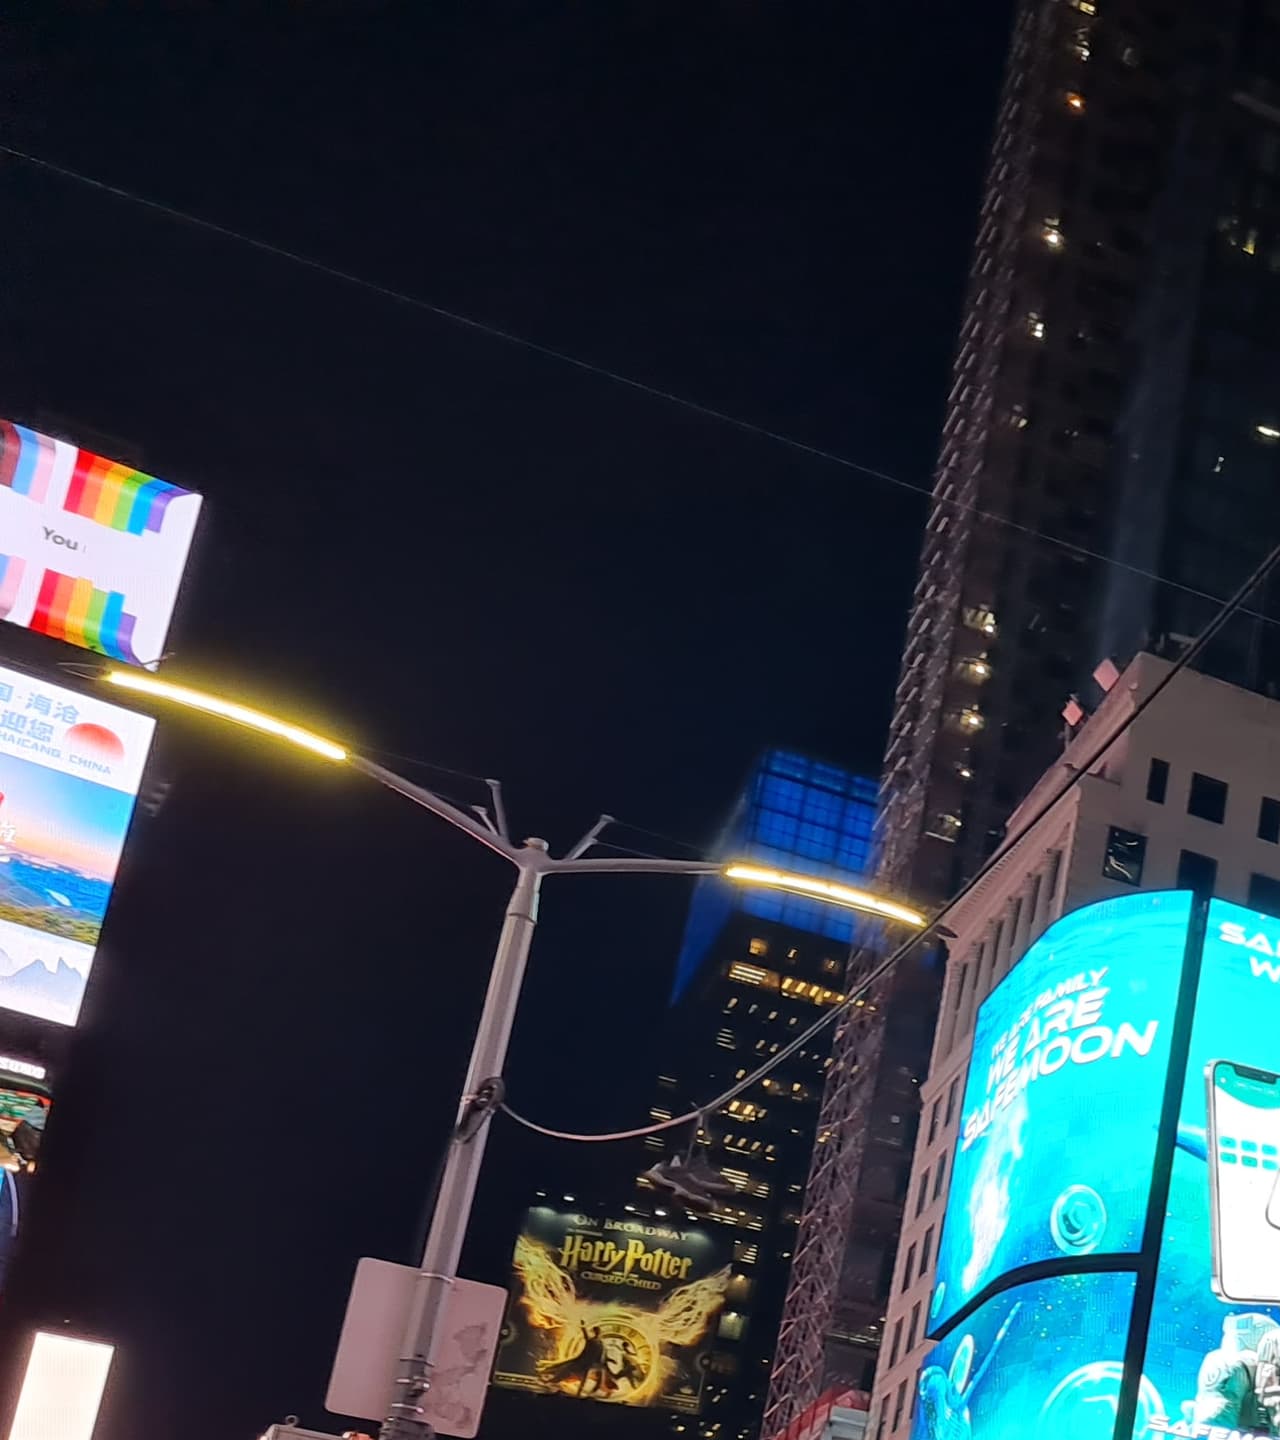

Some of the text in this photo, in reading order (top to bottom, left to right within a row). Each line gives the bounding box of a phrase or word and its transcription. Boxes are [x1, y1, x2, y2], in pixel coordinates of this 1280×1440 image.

[42, 525, 79, 550] You
[68, 754, 112, 776] CHINA
[1021, 986, 1111, 1059] ARE
[961, 1019, 1160, 1153] SAFEMOON
[573, 1214, 690, 1242] ON BROADWAY
[559, 1234, 693, 1280] Harry Potter
